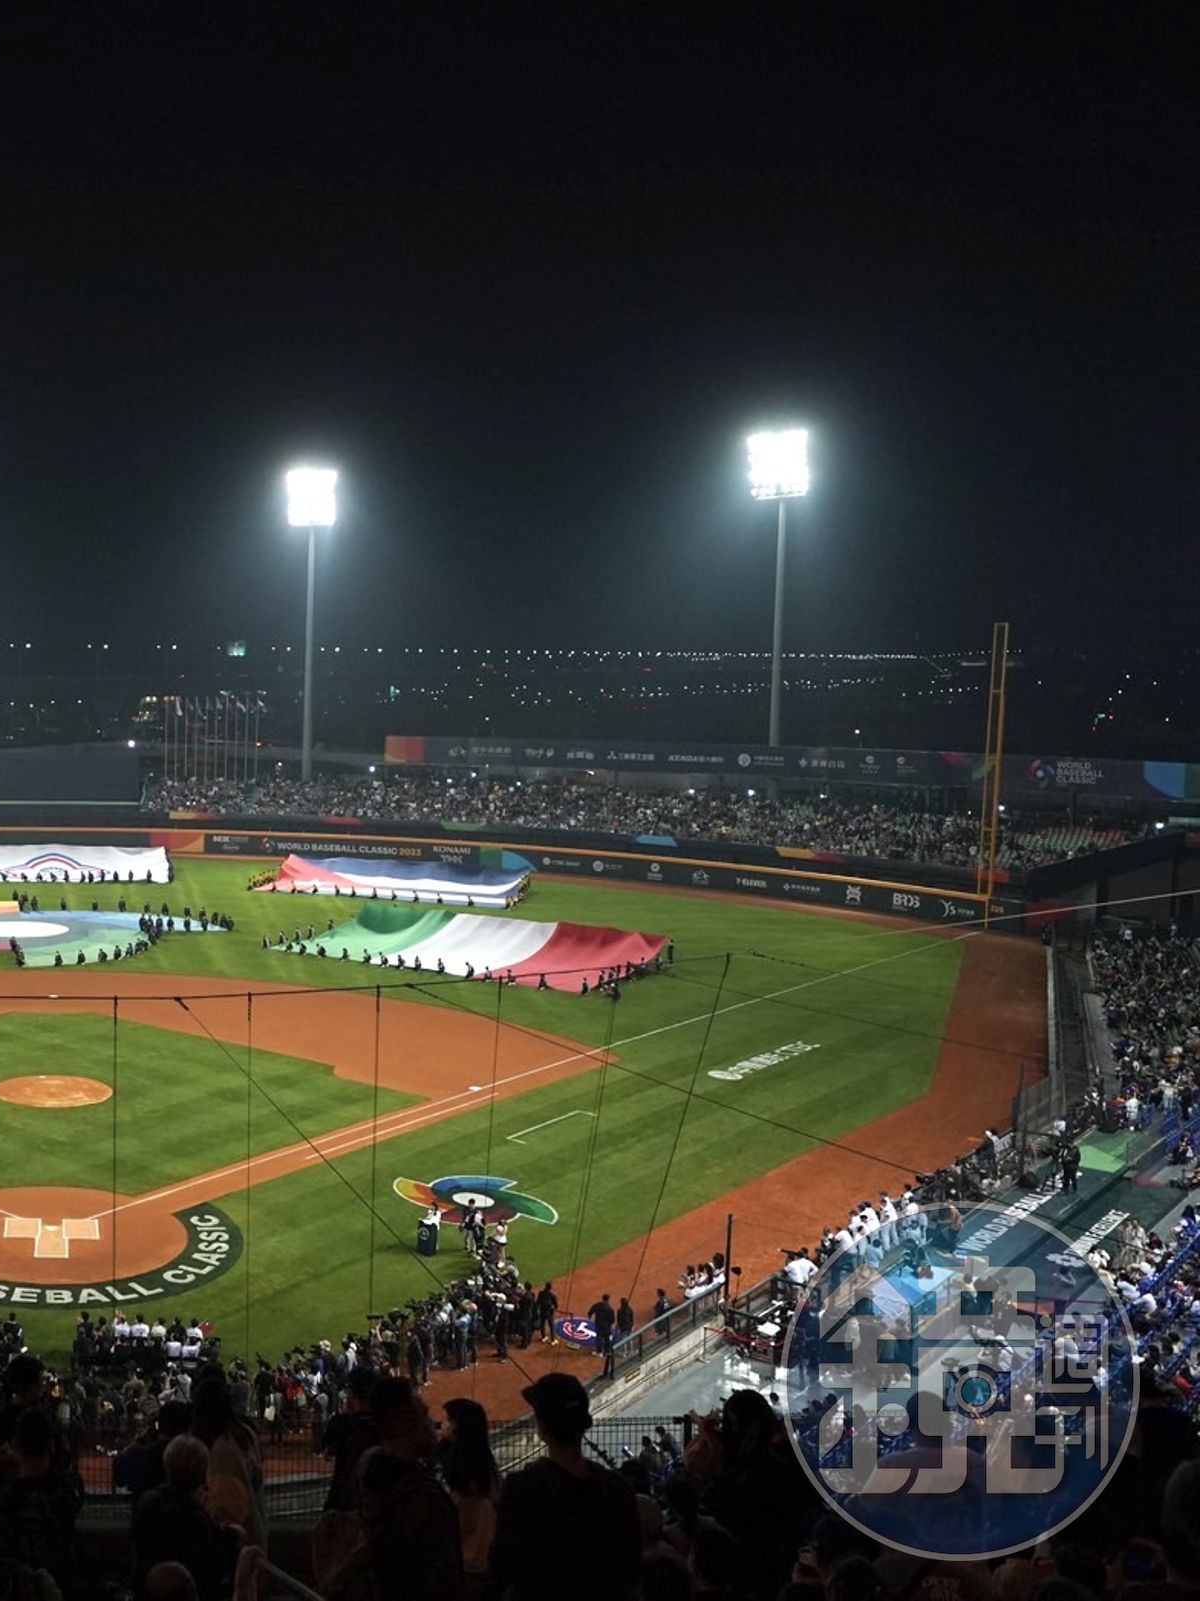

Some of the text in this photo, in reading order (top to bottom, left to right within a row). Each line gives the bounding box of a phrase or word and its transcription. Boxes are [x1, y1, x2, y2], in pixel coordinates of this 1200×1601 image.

[1057, 761, 1092, 770] WORLD
[1056, 768, 1104, 778] BASEBALL
[1056, 776, 1096, 785] CLASSIC
[277, 842, 422, 856] WORLD BASEBALL CLASSIC 2023
[432, 845, 471, 854] KONAMI
[162, 1214, 231, 1286] CLASSIC
